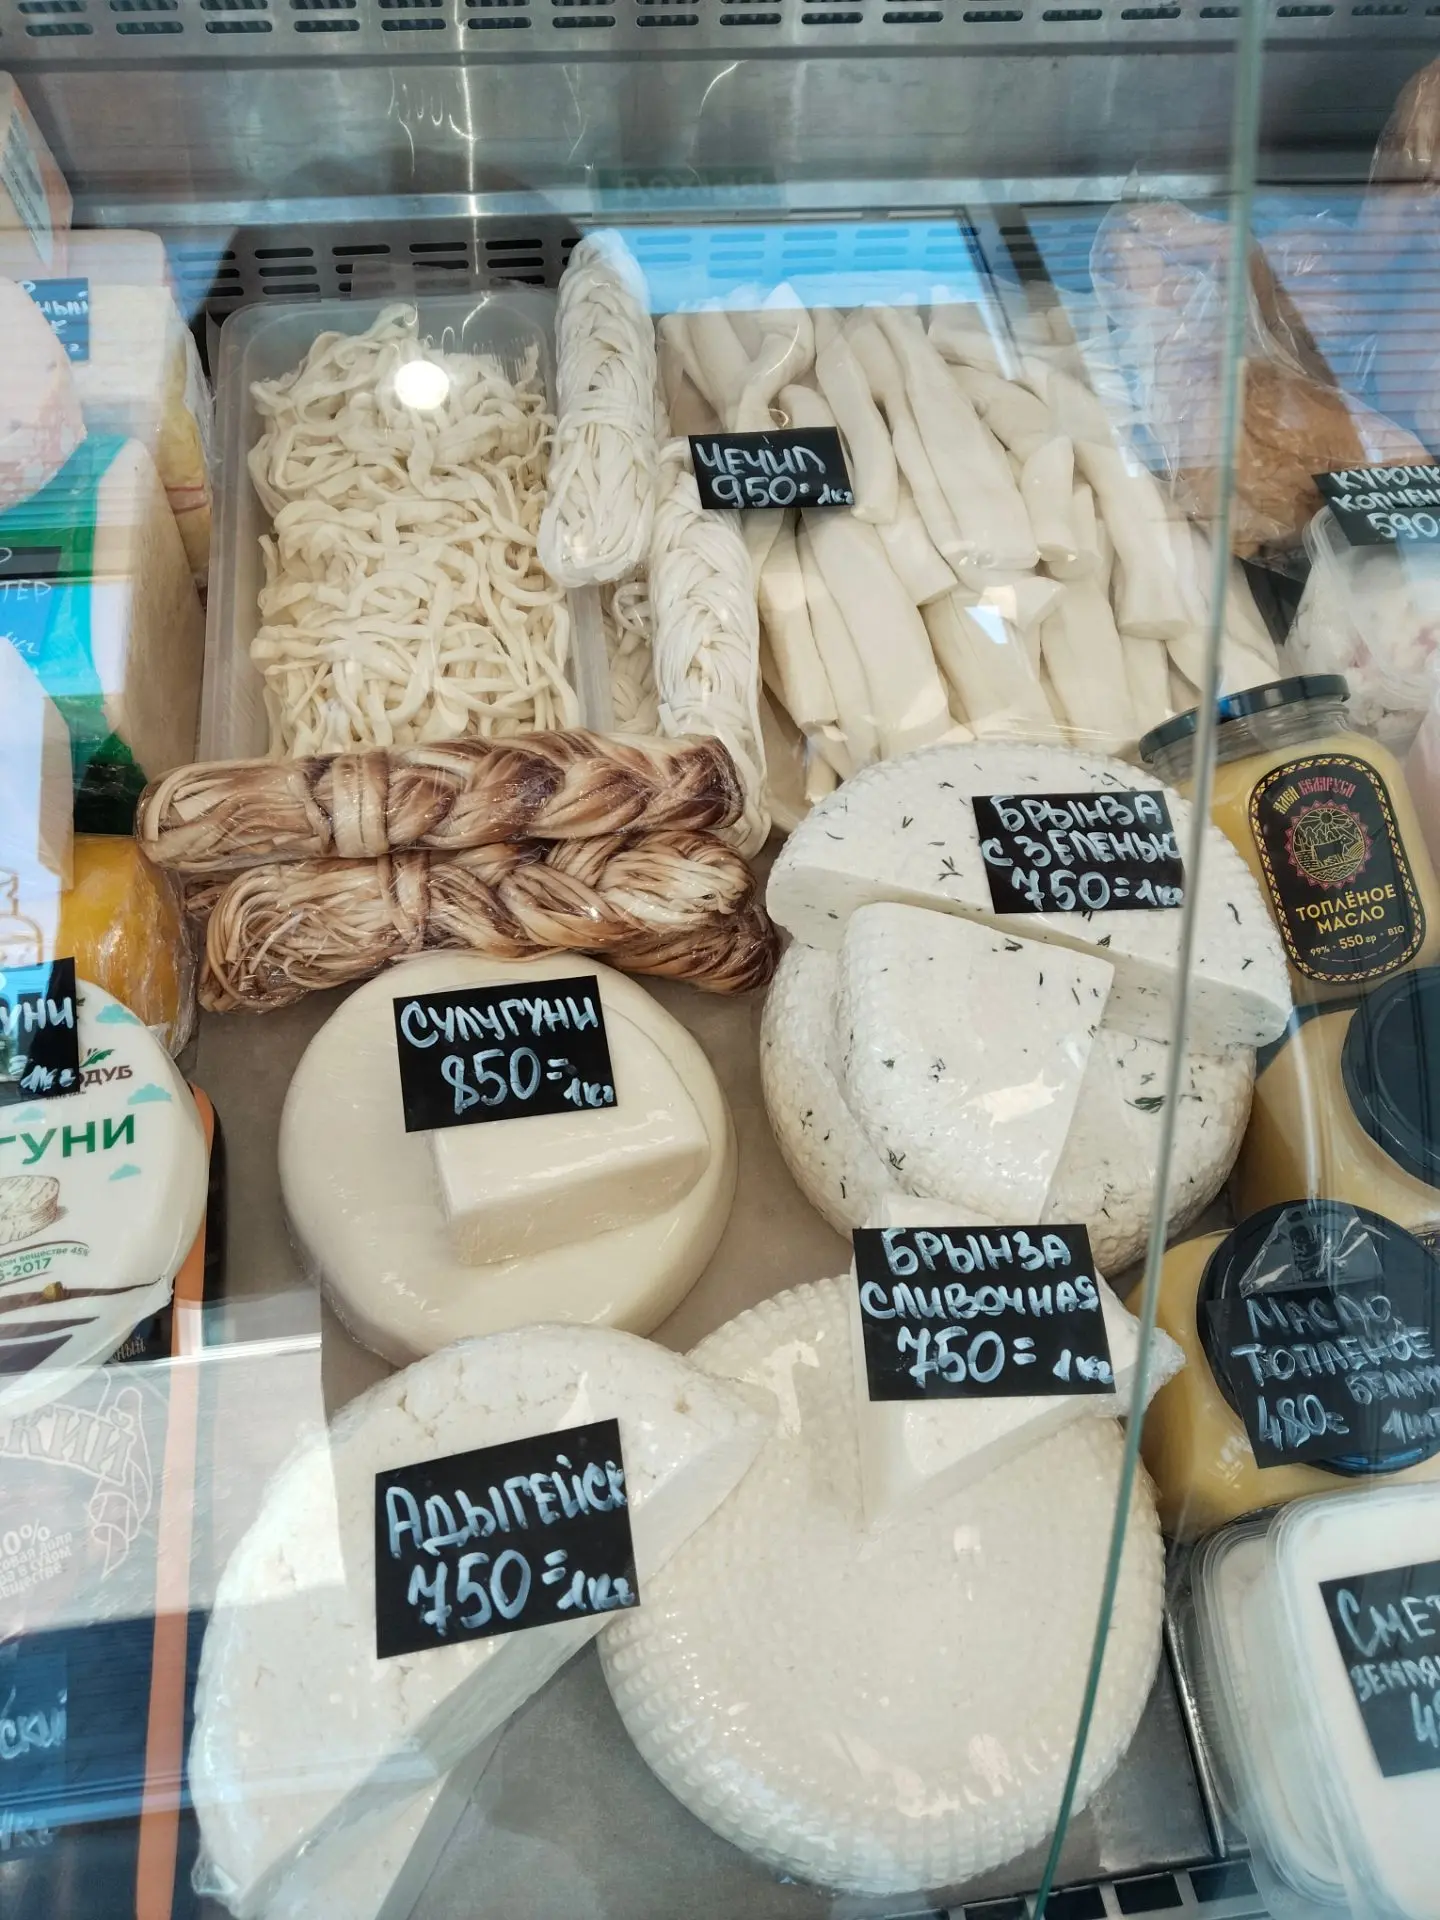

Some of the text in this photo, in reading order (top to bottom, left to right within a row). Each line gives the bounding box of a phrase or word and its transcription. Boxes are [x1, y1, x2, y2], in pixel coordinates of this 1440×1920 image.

[695, 442, 826, 476] ЧЕЧИЛ
[1331, 488, 1440, 512] КОПЧЕН
[990, 793, 1164, 832] БРЫНЗА
[1296, 884, 1397, 921] ТОПЛЁНОЕ
[1316, 905, 1385, 934] МАСЛО
[1339, 934, 1364, 950] 550
[400, 996, 599, 1049] СУЛУГУНИ
[881, 1226, 1071, 1276] БРЫНЗА
[860, 1275, 1099, 1320] СЛИВОЧНАЯ
[1247, 1294, 1392, 1340] МАСЛО
[385, 1454, 628, 1559] АДЫГЕЙСК
[0, 1518, 52, 1557] 0%
